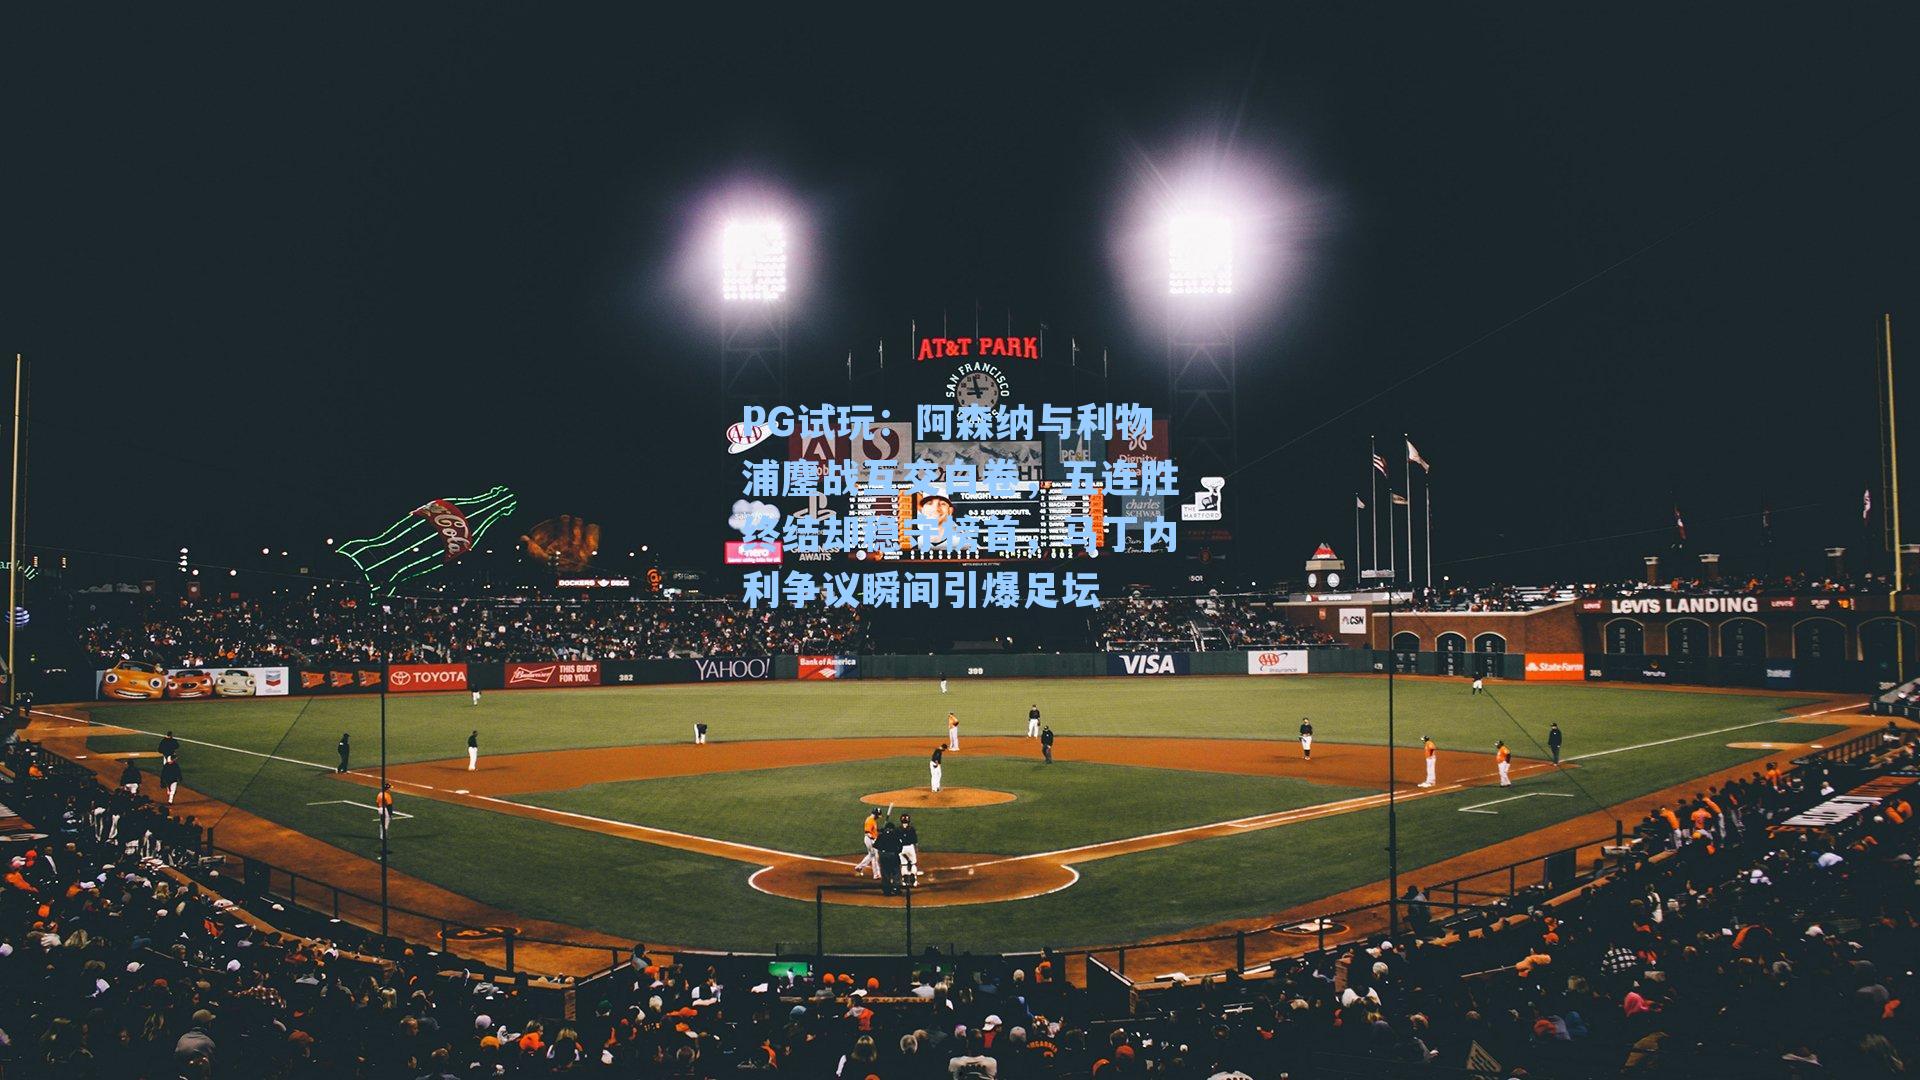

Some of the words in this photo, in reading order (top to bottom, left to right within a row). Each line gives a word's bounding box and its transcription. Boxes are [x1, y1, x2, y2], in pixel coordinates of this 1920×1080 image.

[917, 337, 972, 361] AT&T
[978, 336, 1038, 359] PARK
[946, 374, 960, 398] SAN
[958, 361, 1010, 397] FRANCISCO
[1125, 499, 1160, 510] charles
[799, 552, 832, 562] AWAITS
[1665, 597, 1759, 613] LANDING
[1350, 616, 1364, 625] CSN
[800, 658, 818, 666] Bank
[818, 657, 827, 666] of
[827, 658, 857, 666] America
[1118, 655, 1175, 675] VISA
[515, 669, 552, 679] Budweiser
[560, 665, 576, 673] THIS
[576, 664, 597, 673] BUD'S
[695, 658, 771, 681] YAHOO!
[413, 671, 467, 683] TOYOTA
[560, 674, 573, 682] FOR
[574, 673, 590, 682] YOU.
